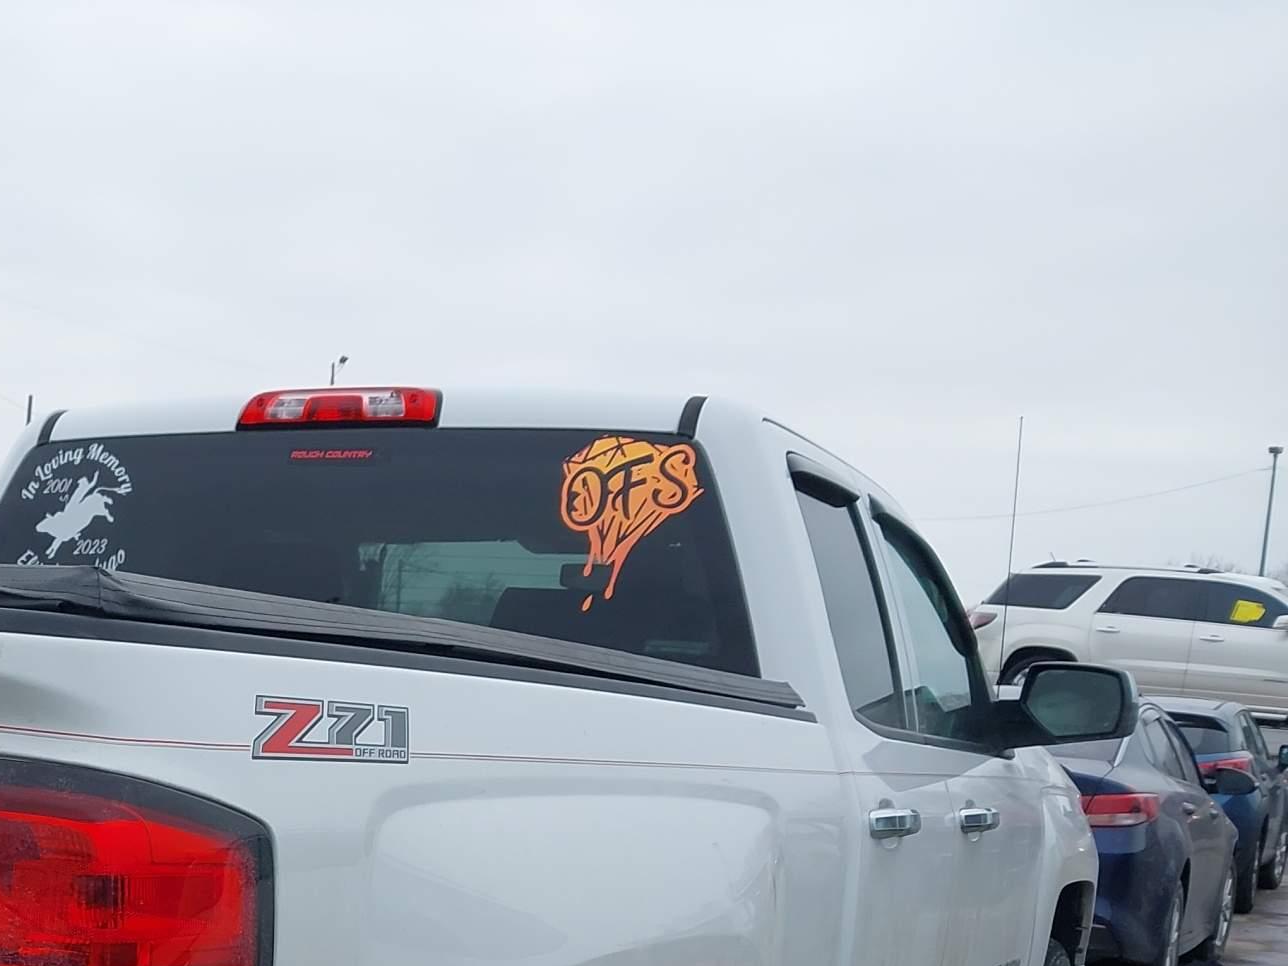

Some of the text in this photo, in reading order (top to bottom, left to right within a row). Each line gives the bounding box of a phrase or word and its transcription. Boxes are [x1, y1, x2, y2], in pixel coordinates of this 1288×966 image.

[325, 450, 372, 458] COUNTRY
[21, 443, 132, 500] In Loving Memory
[43, 478, 73, 494] 2001
[566, 449, 689, 526] OFS
[73, 538, 108, 555] 2023
[252, 695, 409, 764] Z71
[355, 748, 406, 759] OFF ROAD
